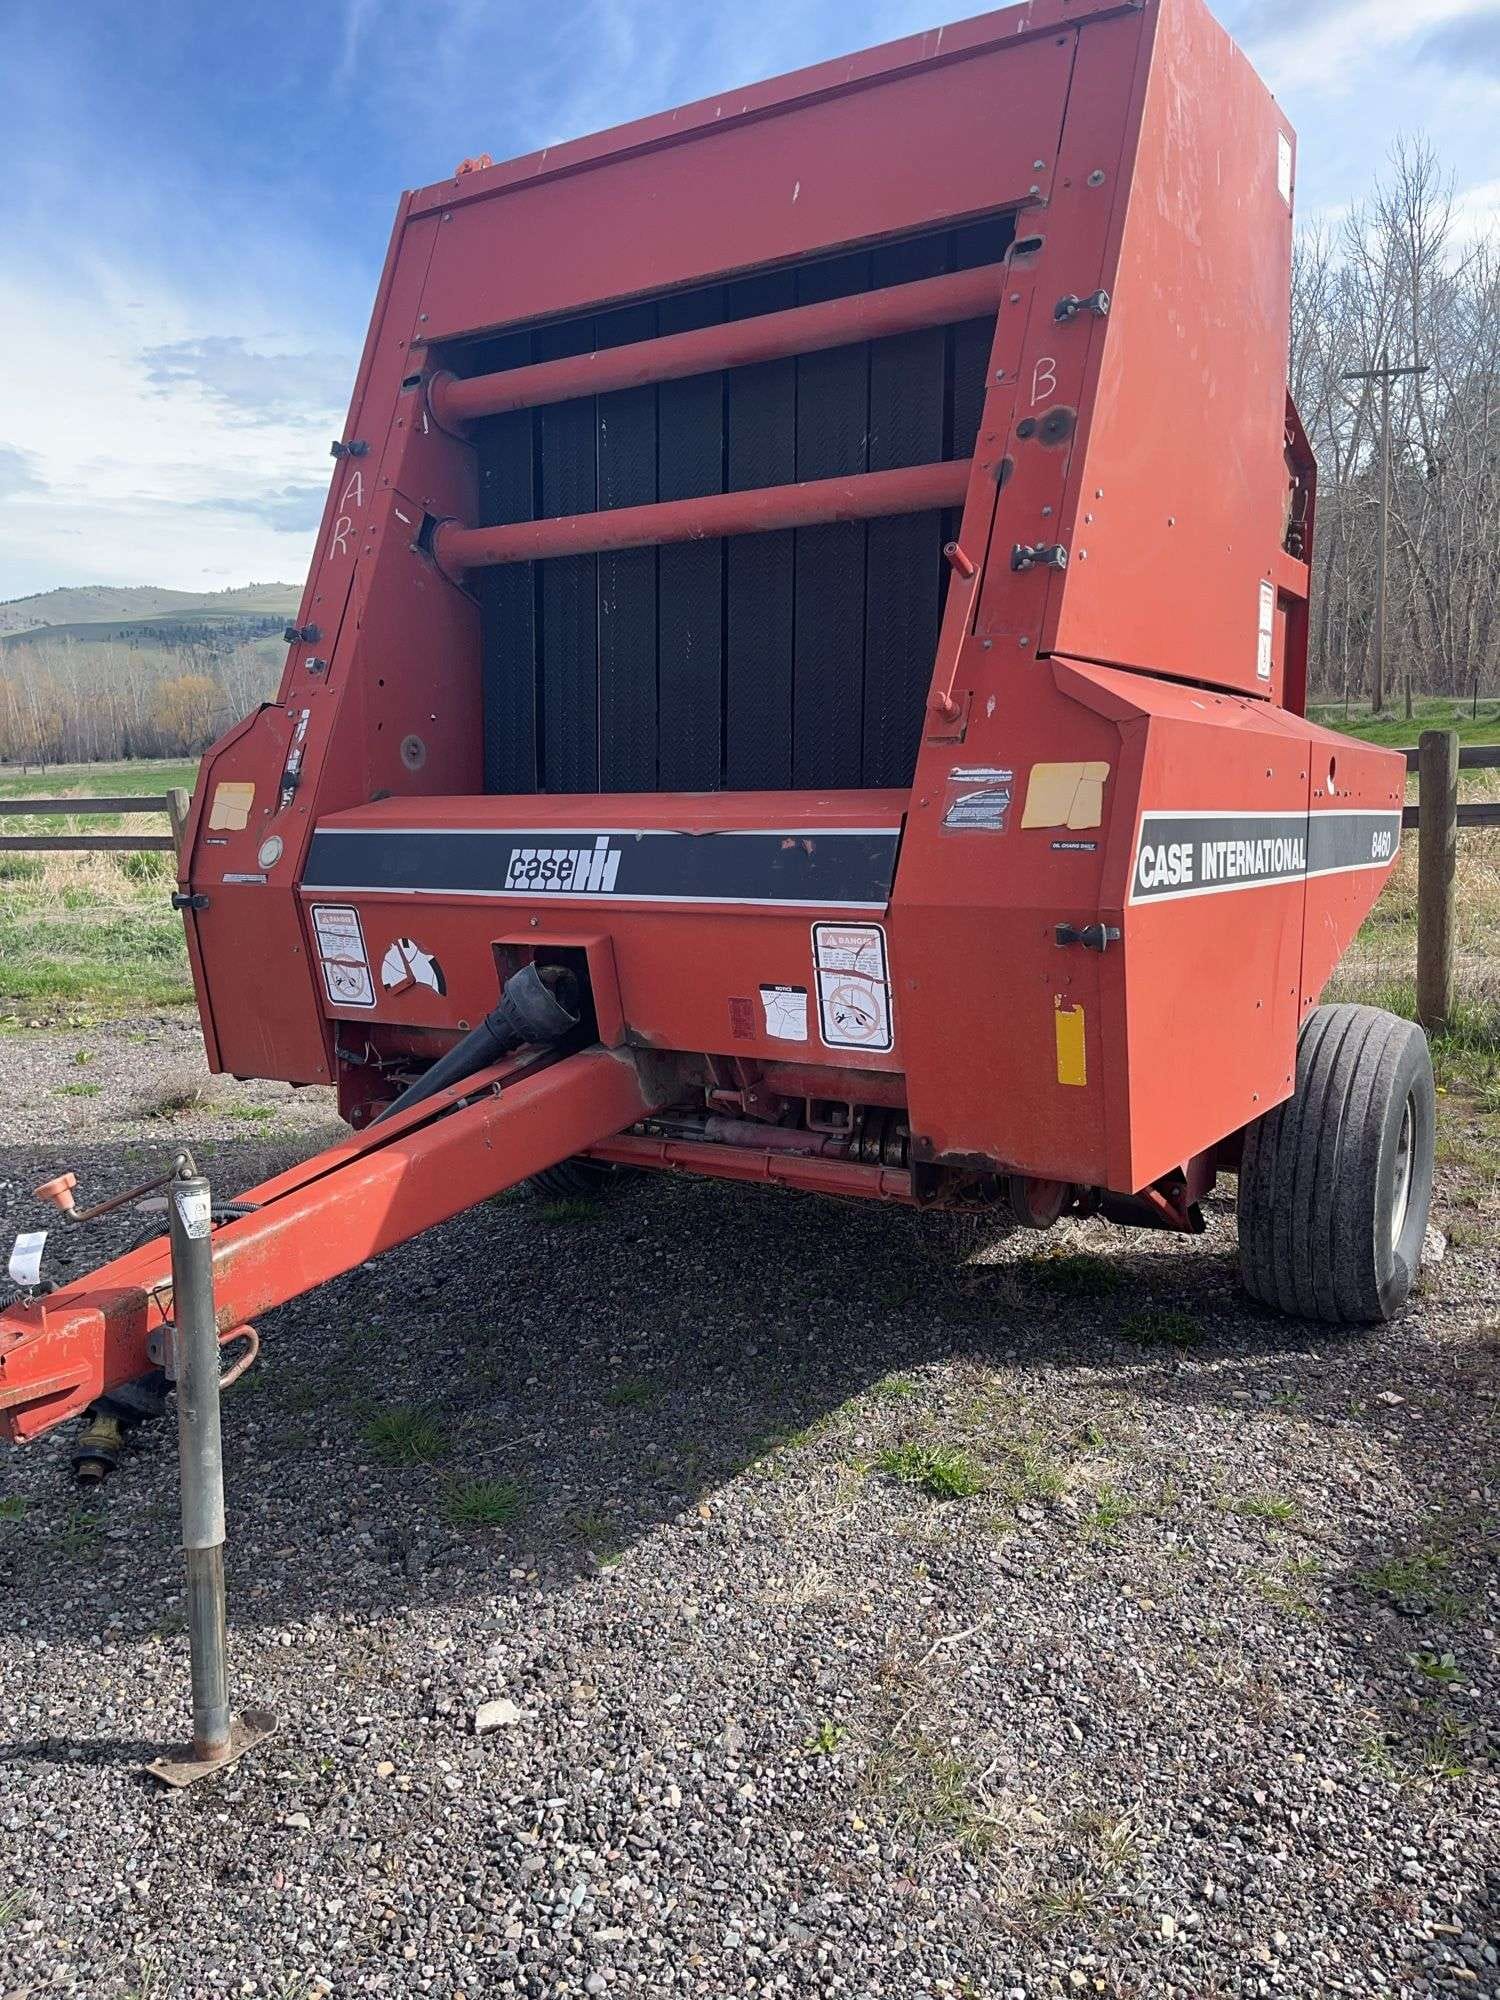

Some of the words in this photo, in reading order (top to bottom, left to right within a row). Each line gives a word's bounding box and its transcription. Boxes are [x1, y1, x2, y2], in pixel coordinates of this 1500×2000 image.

[1031, 357, 1056, 406] B
[340, 471, 363, 513] A
[330, 516, 352, 560] R
[1139, 843, 1193, 888] CASE
[1201, 837, 1306, 880] INTERNATIONAL
[1371, 831, 1391, 858] 8460
